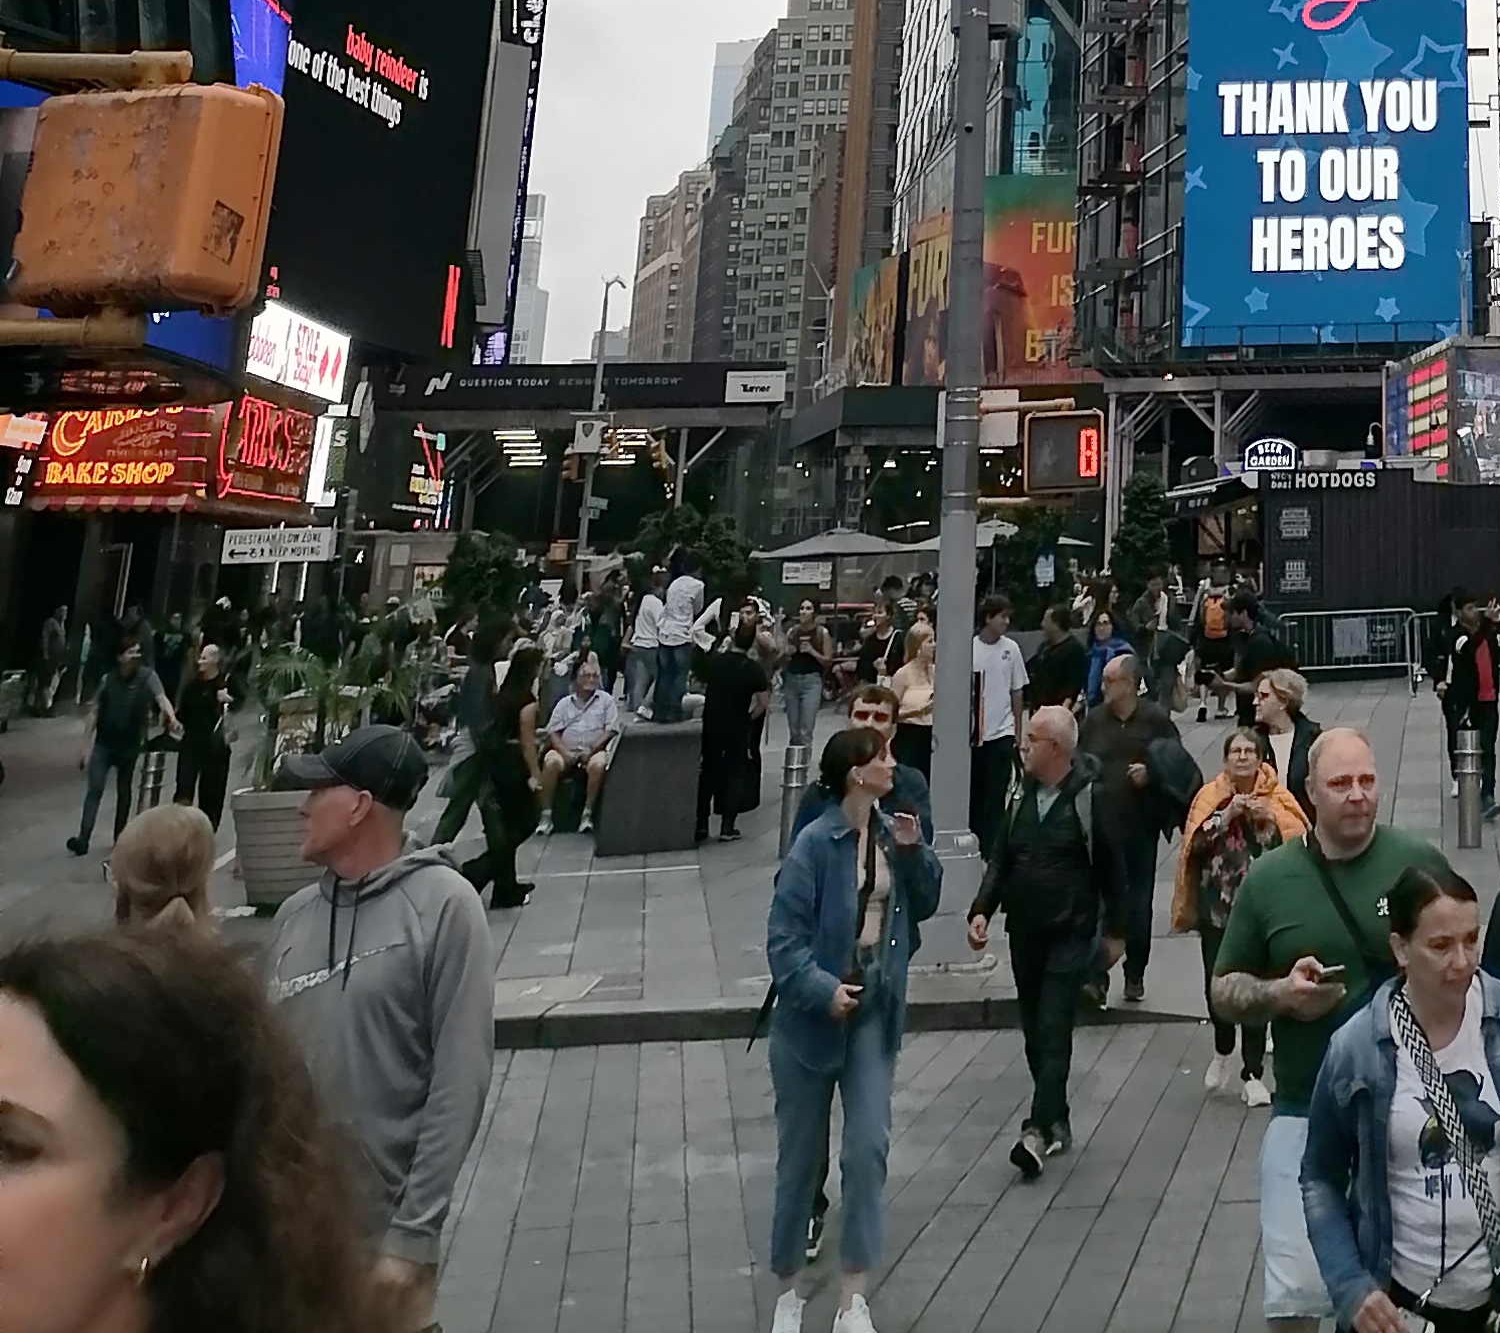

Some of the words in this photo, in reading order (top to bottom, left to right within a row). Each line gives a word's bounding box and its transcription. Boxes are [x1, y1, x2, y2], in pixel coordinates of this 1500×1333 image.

[345, 24, 374, 73] baby
[374, 47, 418, 94] reindeer
[417, 69, 429, 101] is
[311, 50, 327, 83] of
[326, 54, 346, 95] the
[346, 66, 371, 112] best
[370, 79, 402, 128] things
[1217, 80, 1353, 136] THANK
[1359, 79, 1438, 134] YOU
[1256, 149, 1312, 203] TO
[1319, 147, 1398, 202] OUR
[1250, 215, 1404, 273] HEROES
[459, 378, 512, 387] QUESTION
[516, 378, 550, 387] TODAY
[614, 376, 680, 386] TOMORROW
[740, 383, 771, 394] Turner
[1257, 442, 1283, 455] BEER
[1249, 454, 1290, 467] GARDEN
[45, 461, 109, 484] BAKE
[110, 461, 175, 484] SHOP
[1295, 471, 1377, 489] HOTDOGS
[228, 533, 277, 545] PEDESTRIAN
[279, 533, 301, 544] FLOW
[301, 532, 322, 543] ZONE
[268, 547, 290, 558] KEEP
[290, 545, 321, 557] MOVING
